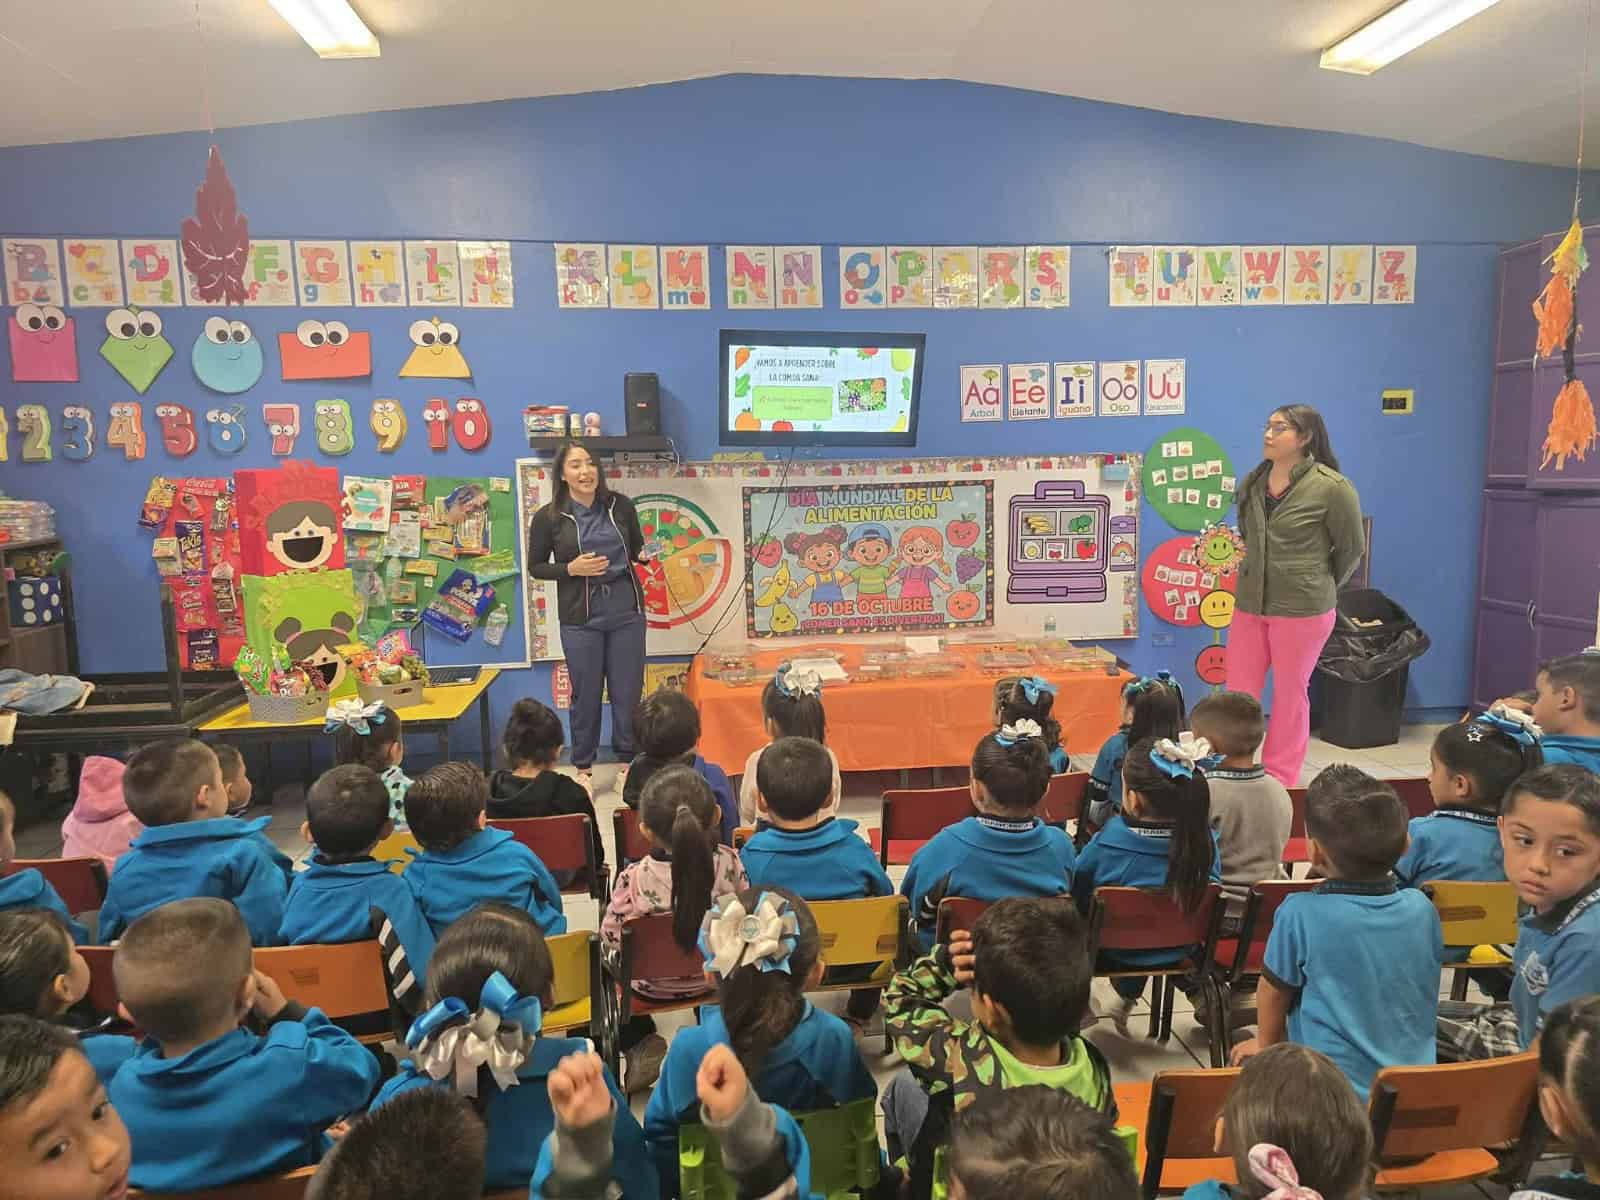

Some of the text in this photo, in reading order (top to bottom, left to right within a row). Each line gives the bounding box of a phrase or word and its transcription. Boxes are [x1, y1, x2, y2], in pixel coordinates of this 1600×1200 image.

[134, 245, 169, 282] D
[254, 245, 279, 282] F
[300, 247, 340, 284] G
[359, 246, 396, 282] H
[622, 251, 647, 286] L
[666, 250, 703, 288] M
[734, 251, 766, 288] N
[899, 250, 926, 286] P
[986, 252, 1016, 287] R
[1036, 251, 1057, 286] S
[1161, 252, 1188, 284] U
[1203, 251, 1232, 284] V
[1244, 252, 1281, 284] W
[1294, 251, 1321, 284] X
[1382, 251, 1406, 283] Z
[73, 285, 89, 301] c
[304, 285, 319, 302] g
[360, 282, 375, 303] h
[668, 291, 689, 304] m
[733, 289, 748, 304] n
[844, 289, 859, 304] o
[892, 285, 906, 304] p
[1157, 287, 1170, 300] u
[1245, 287, 1261, 299] w
[965, 380, 1000, 406] Aa
[1012, 378, 1046, 405] Ee
[1060, 376, 1086, 405] Ii
[1102, 377, 1138, 402] Oo
[1148, 372, 1181, 400] Uu
[16, 403, 53, 463] 2
[63, 405, 96, 462] 3
[107, 402, 147, 461] 4
[156, 402, 198, 459] 5
[207, 403, 249, 454] 6
[263, 402, 301, 456] 7
[313, 399, 355, 455] 8
[369, 399, 408, 453] 9
[423, 398, 493, 452] 10
[823, 489, 901, 505] MUNDIAL
[904, 487, 928, 503] DE
[932, 486, 953, 502] LA
[804, 503, 937, 523] ALIMENTACIÓN
[809, 598, 934, 616] 16 DE OCTUBRE
